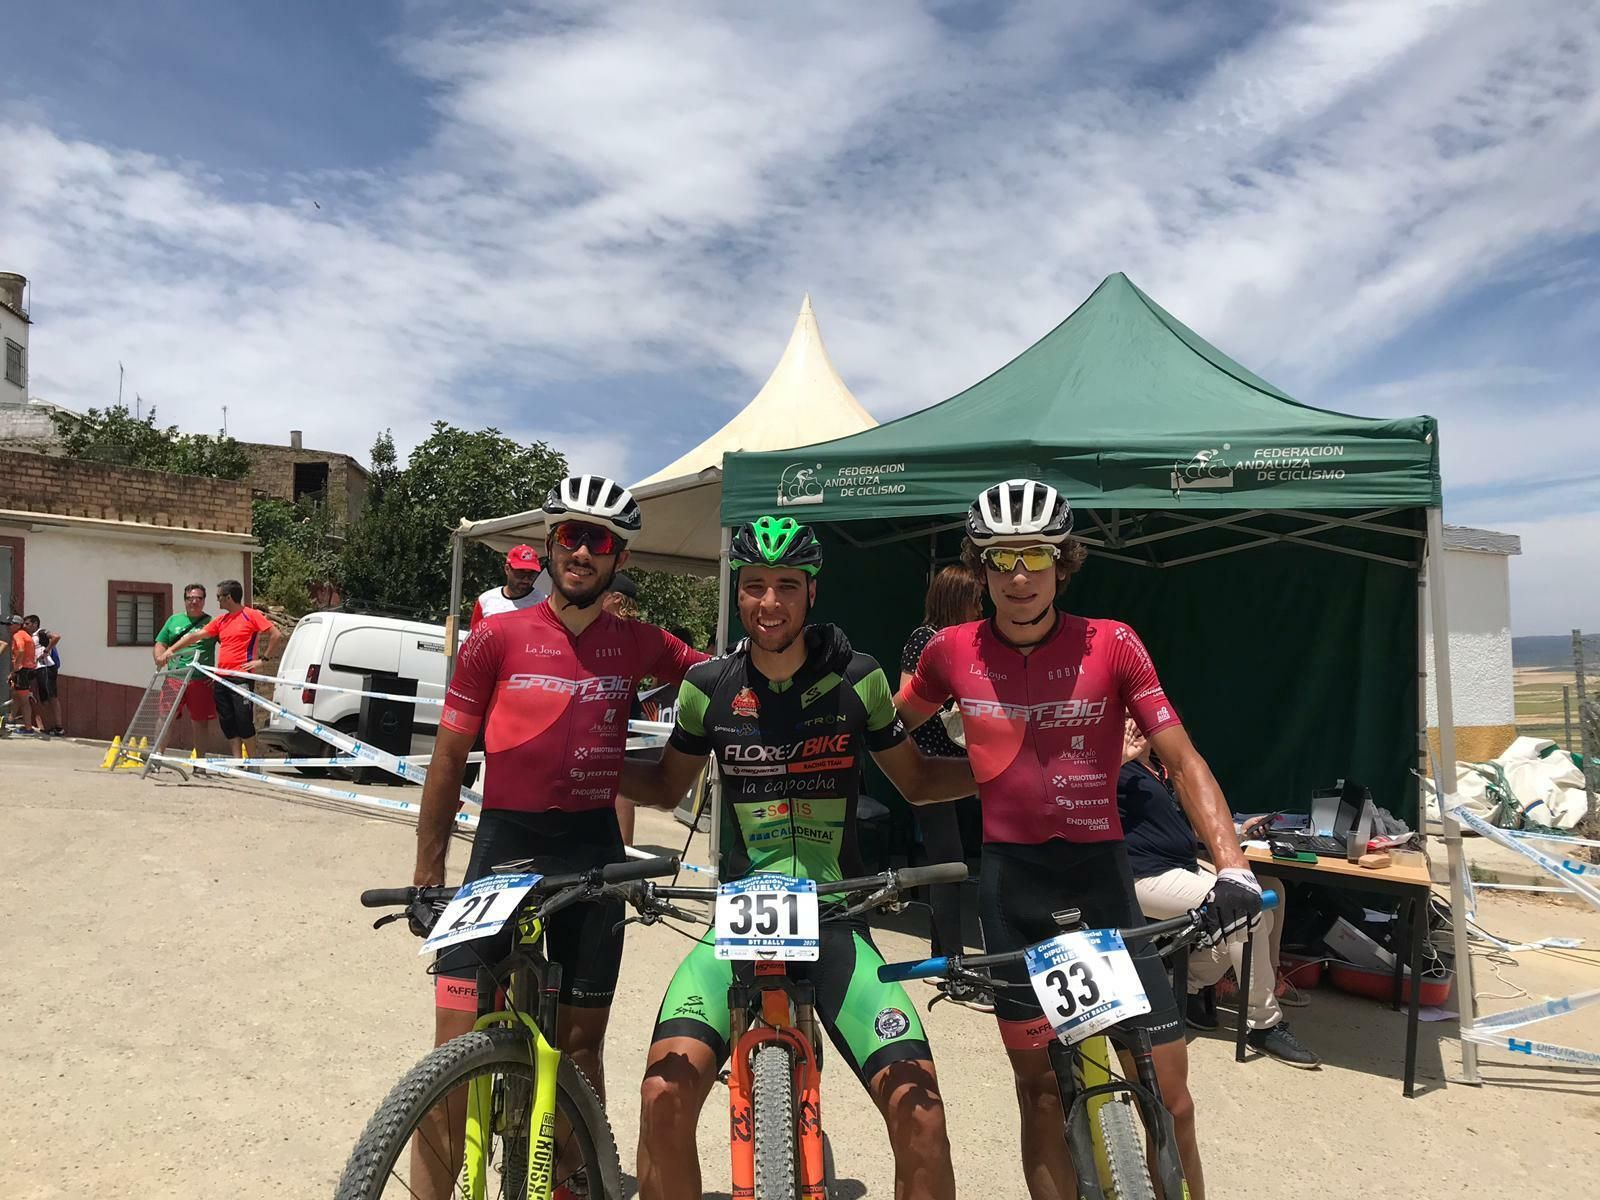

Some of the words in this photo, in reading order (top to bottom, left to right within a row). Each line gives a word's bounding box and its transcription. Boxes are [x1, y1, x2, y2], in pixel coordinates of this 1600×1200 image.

[1254, 444, 1344, 458] FEDERACIÓN
[1234, 459, 1311, 470] ANDALUZA
[824, 476, 880, 488] ANDALUZA
[1257, 471, 1275, 481] DE
[1279, 470, 1346, 481] CICLISMO
[840, 488, 854, 497] DE
[856, 484, 906, 496] CICLISMO
[579, 692, 629, 704] SCOTT
[1038, 716, 1105, 730] SCOTT
[802, 734, 851, 758] BIKE
[742, 777, 756, 794] la
[1075, 798, 1110, 806] ROTOR
[1066, 818, 1110, 826] ENDURANCE
[744, 884, 788, 892] HUELVA
[448, 892, 500, 931] 21
[730, 894, 798, 936] 351
[1079, 1014, 1090, 1022] BTT
[1091, 1003, 1113, 1018] RALLY
